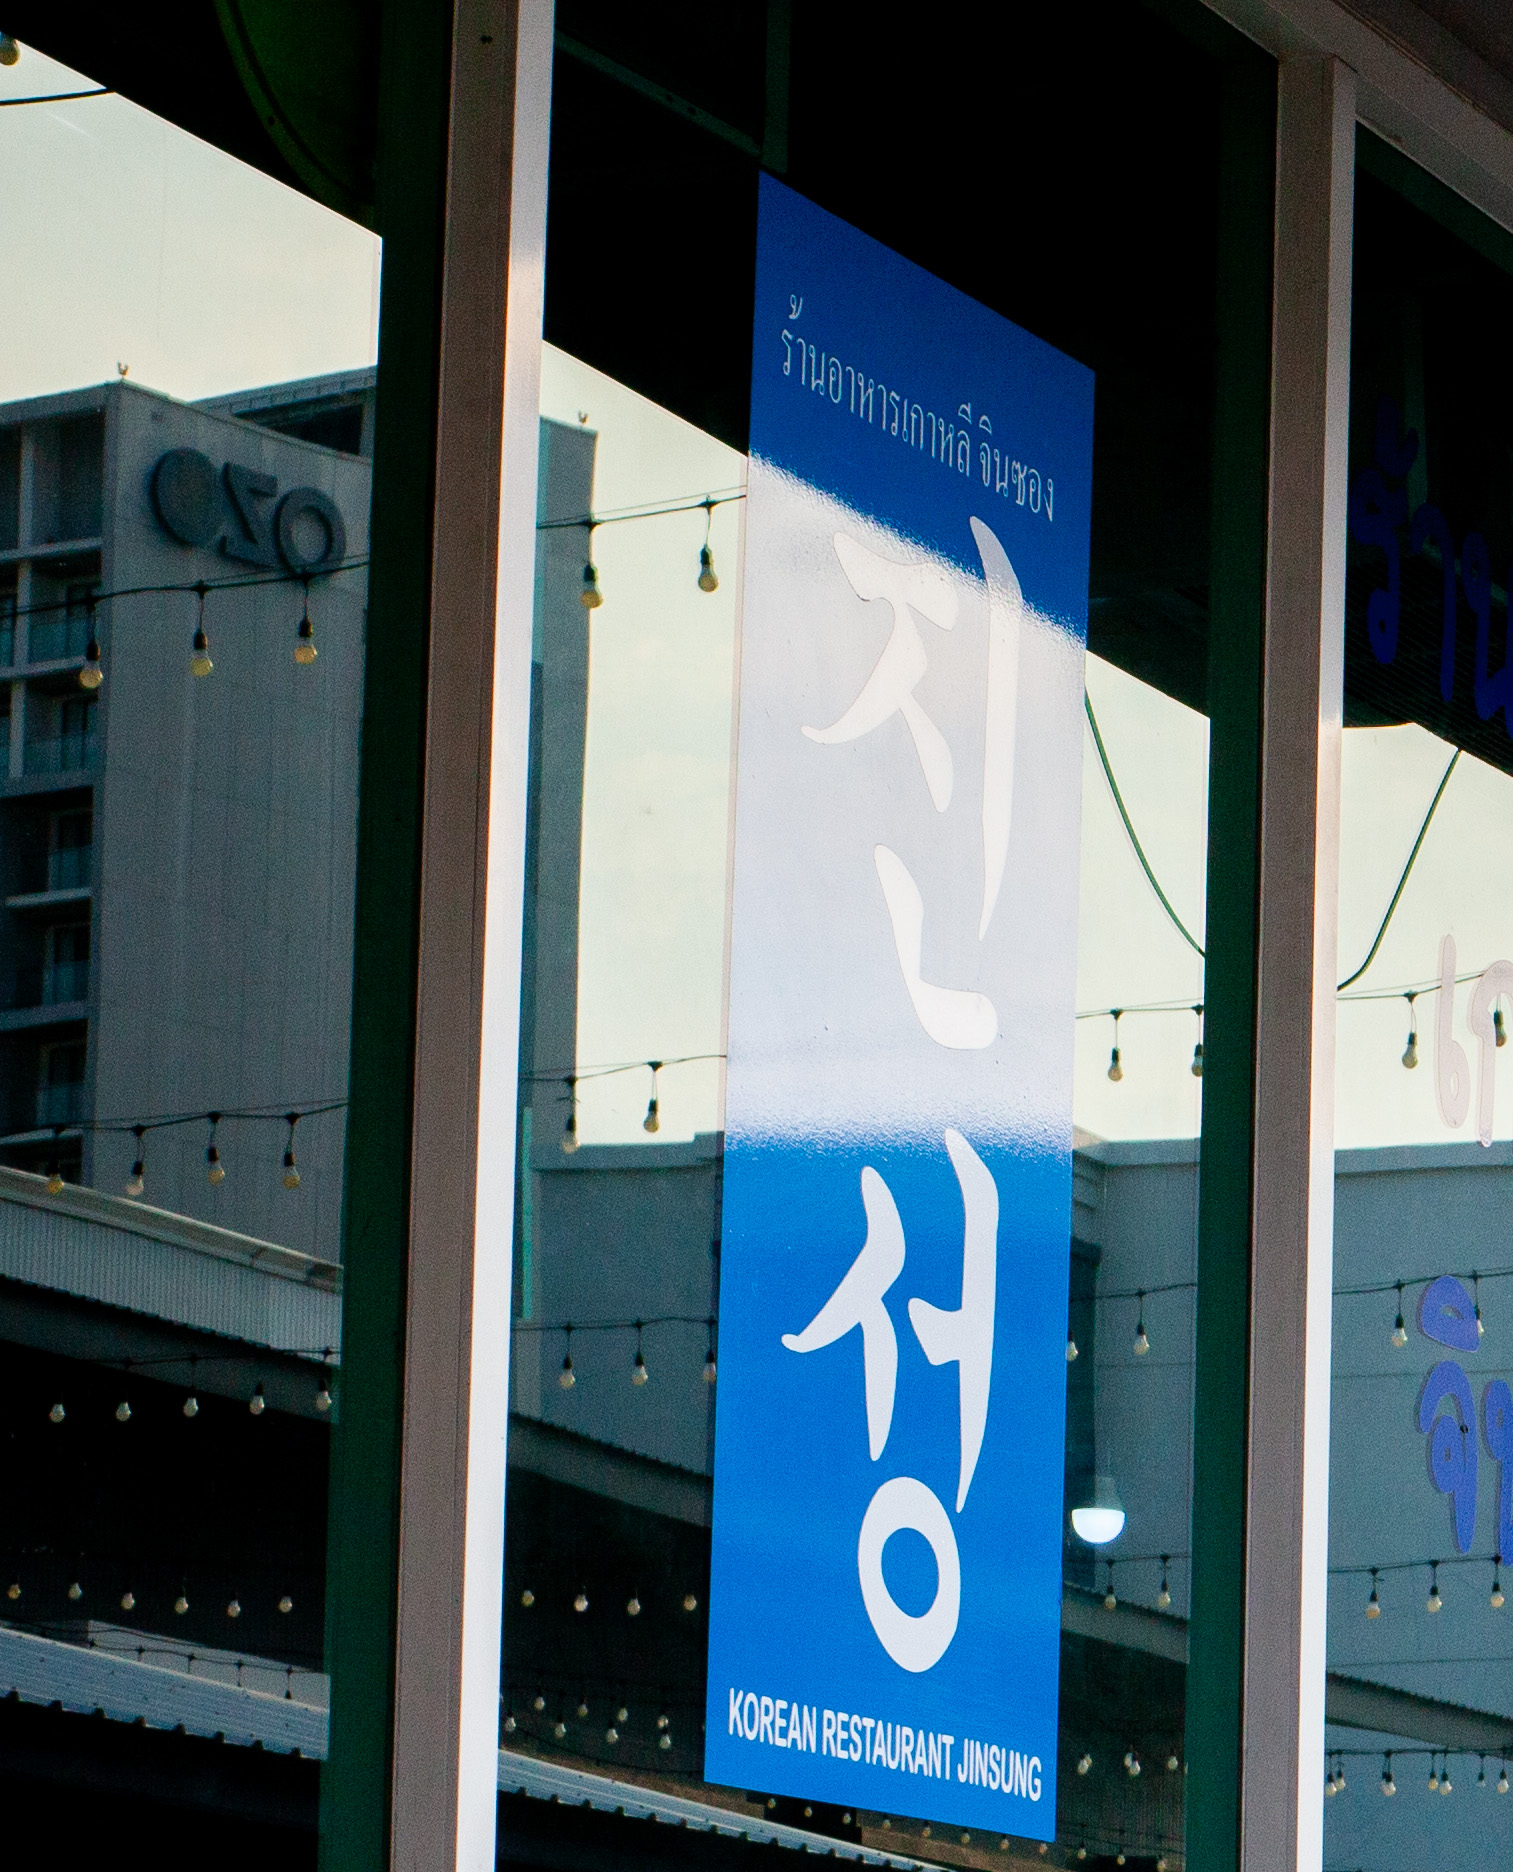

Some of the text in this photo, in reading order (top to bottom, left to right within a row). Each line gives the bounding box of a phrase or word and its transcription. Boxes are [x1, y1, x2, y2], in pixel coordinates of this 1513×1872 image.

[781, 294, 1055, 522] ร้านอาหารเกาหลี จินซอง
[781, 515, 1023, 1673] 진성
[728, 1687, 1042, 1802] KOREAN RESTAURANT JINSUNG
